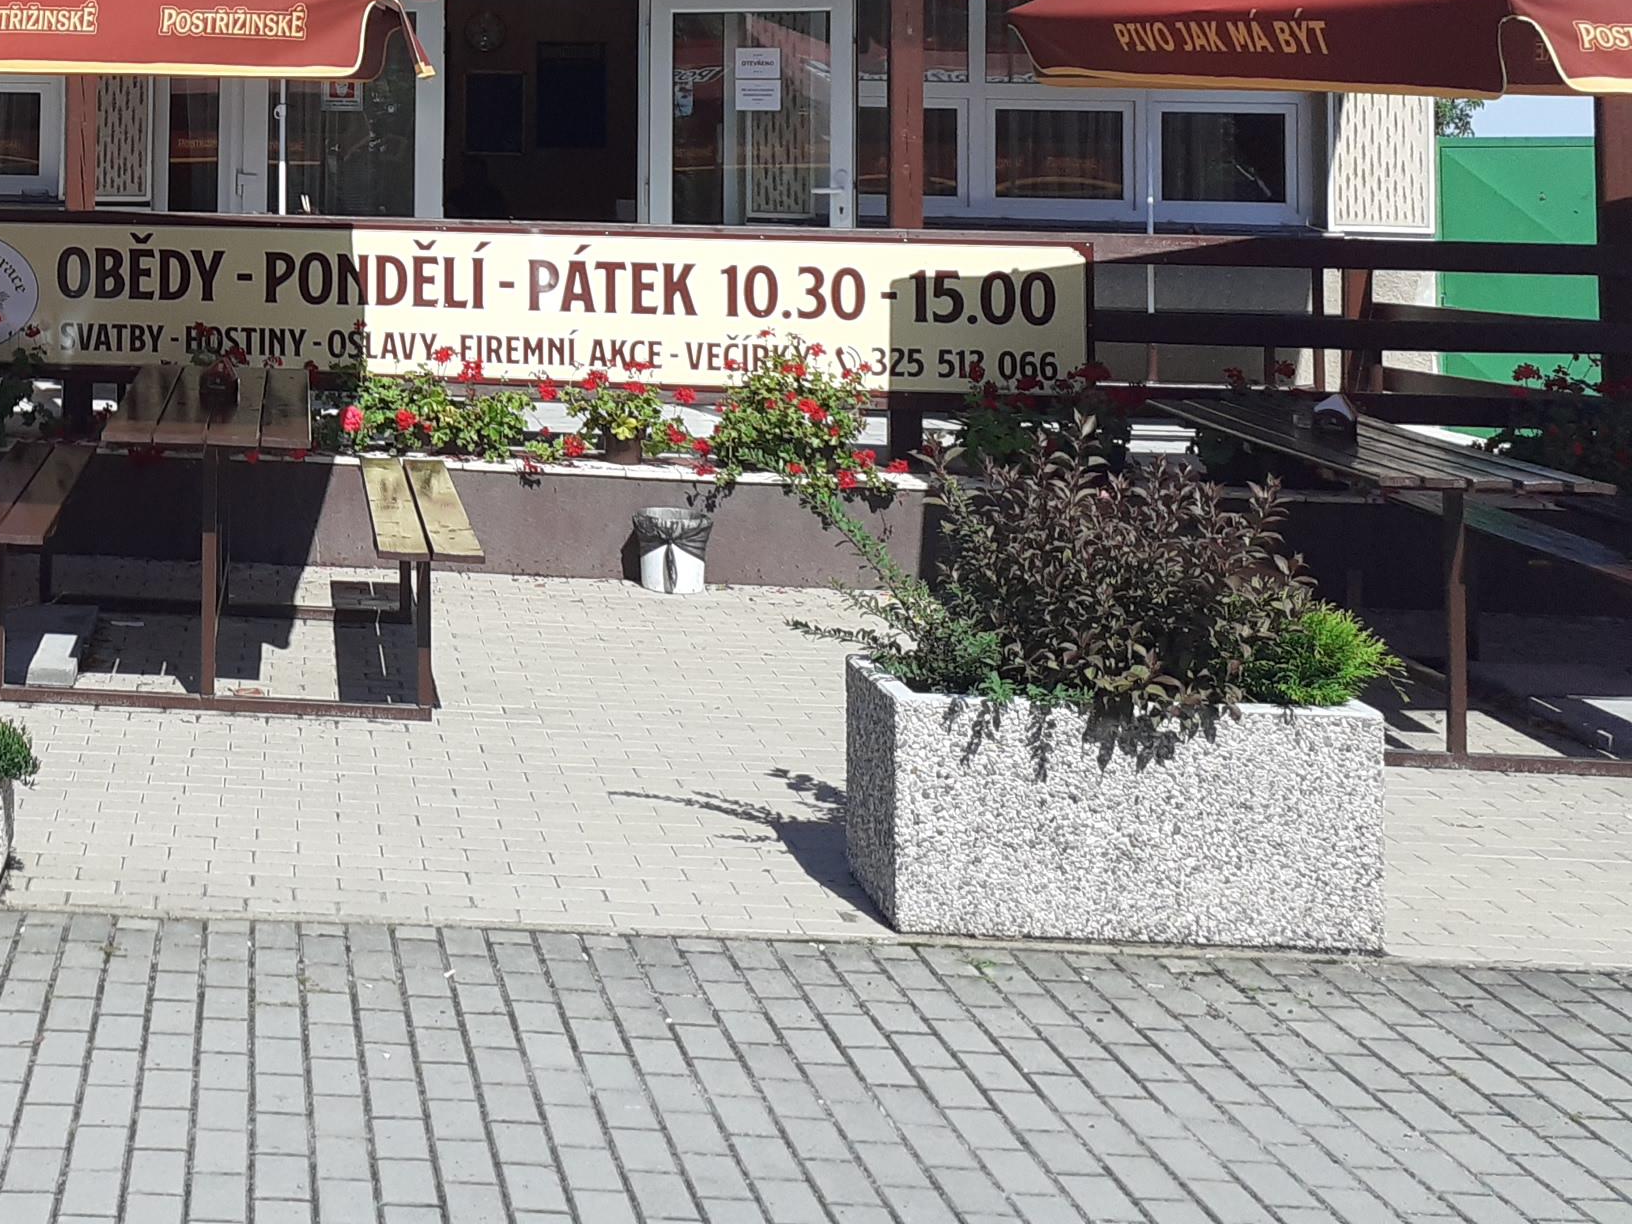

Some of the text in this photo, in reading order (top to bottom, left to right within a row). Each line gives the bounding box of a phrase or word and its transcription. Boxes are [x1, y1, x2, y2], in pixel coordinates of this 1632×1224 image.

[159, 4, 307, 39] POSTŘIŽINSKÉ
[1113, 7, 1329, 55] PIVO JAK MÁ BÝT
[57, 232, 226, 302] OBĚDY
[264, 239, 492, 310] PONDĚLÍ
[528, 244, 698, 316] PÁTEK
[720, 264, 866, 321] 10.30
[908, 268, 1057, 328] 15.00
[60, 322, 166, 354] SVATBY
[185, 326, 307, 357] HOSTINY
[327, 329, 438, 361] OSLAVY
[589, 338, 663, 369] AKCE
[871, 347, 925, 378] 325
[998, 350, 1058, 381] 066
